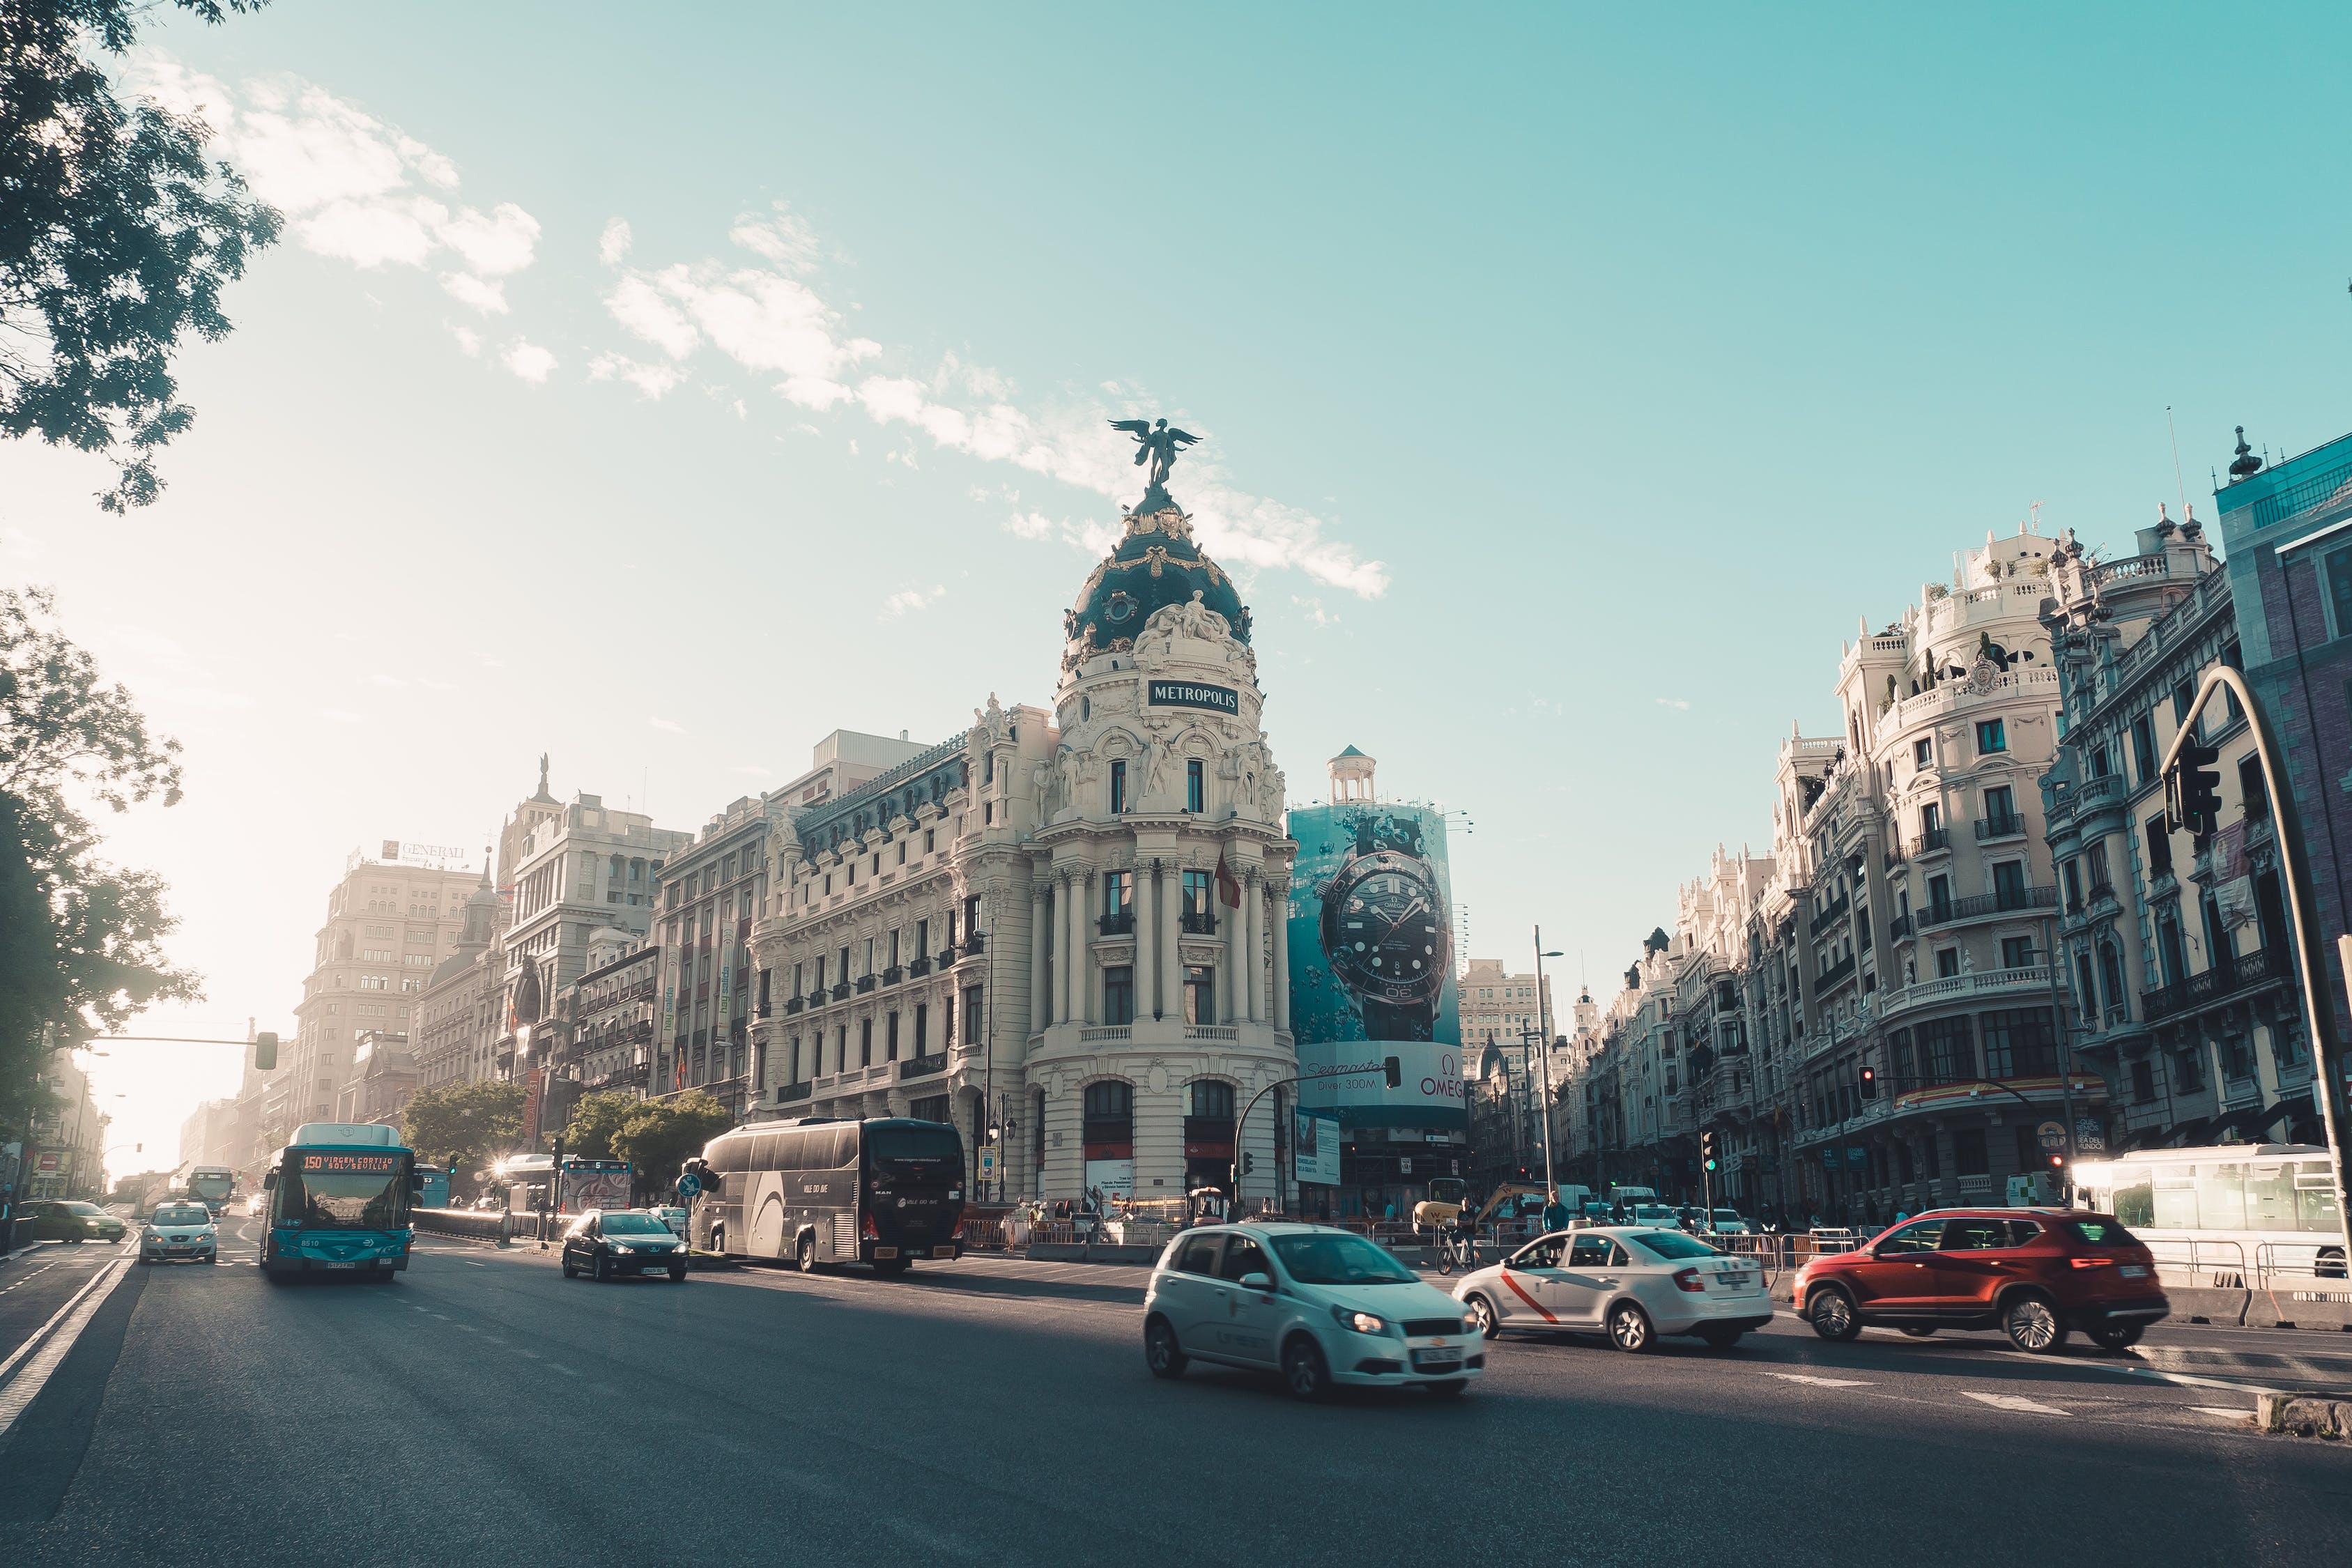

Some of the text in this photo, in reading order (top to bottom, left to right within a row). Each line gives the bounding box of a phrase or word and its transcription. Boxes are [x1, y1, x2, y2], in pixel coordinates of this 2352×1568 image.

[1155, 686, 1236, 708] METROPOLIS
[1394, 960, 1400, 969] 8
[720, 966, 730, 1014] hay salida
[663, 987, 674, 1031] hay salida
[1318, 1079, 1377, 1091] Diver 300M
[1420, 1077, 1463, 1098] OMEG
[305, 1156, 322, 1169] 150
